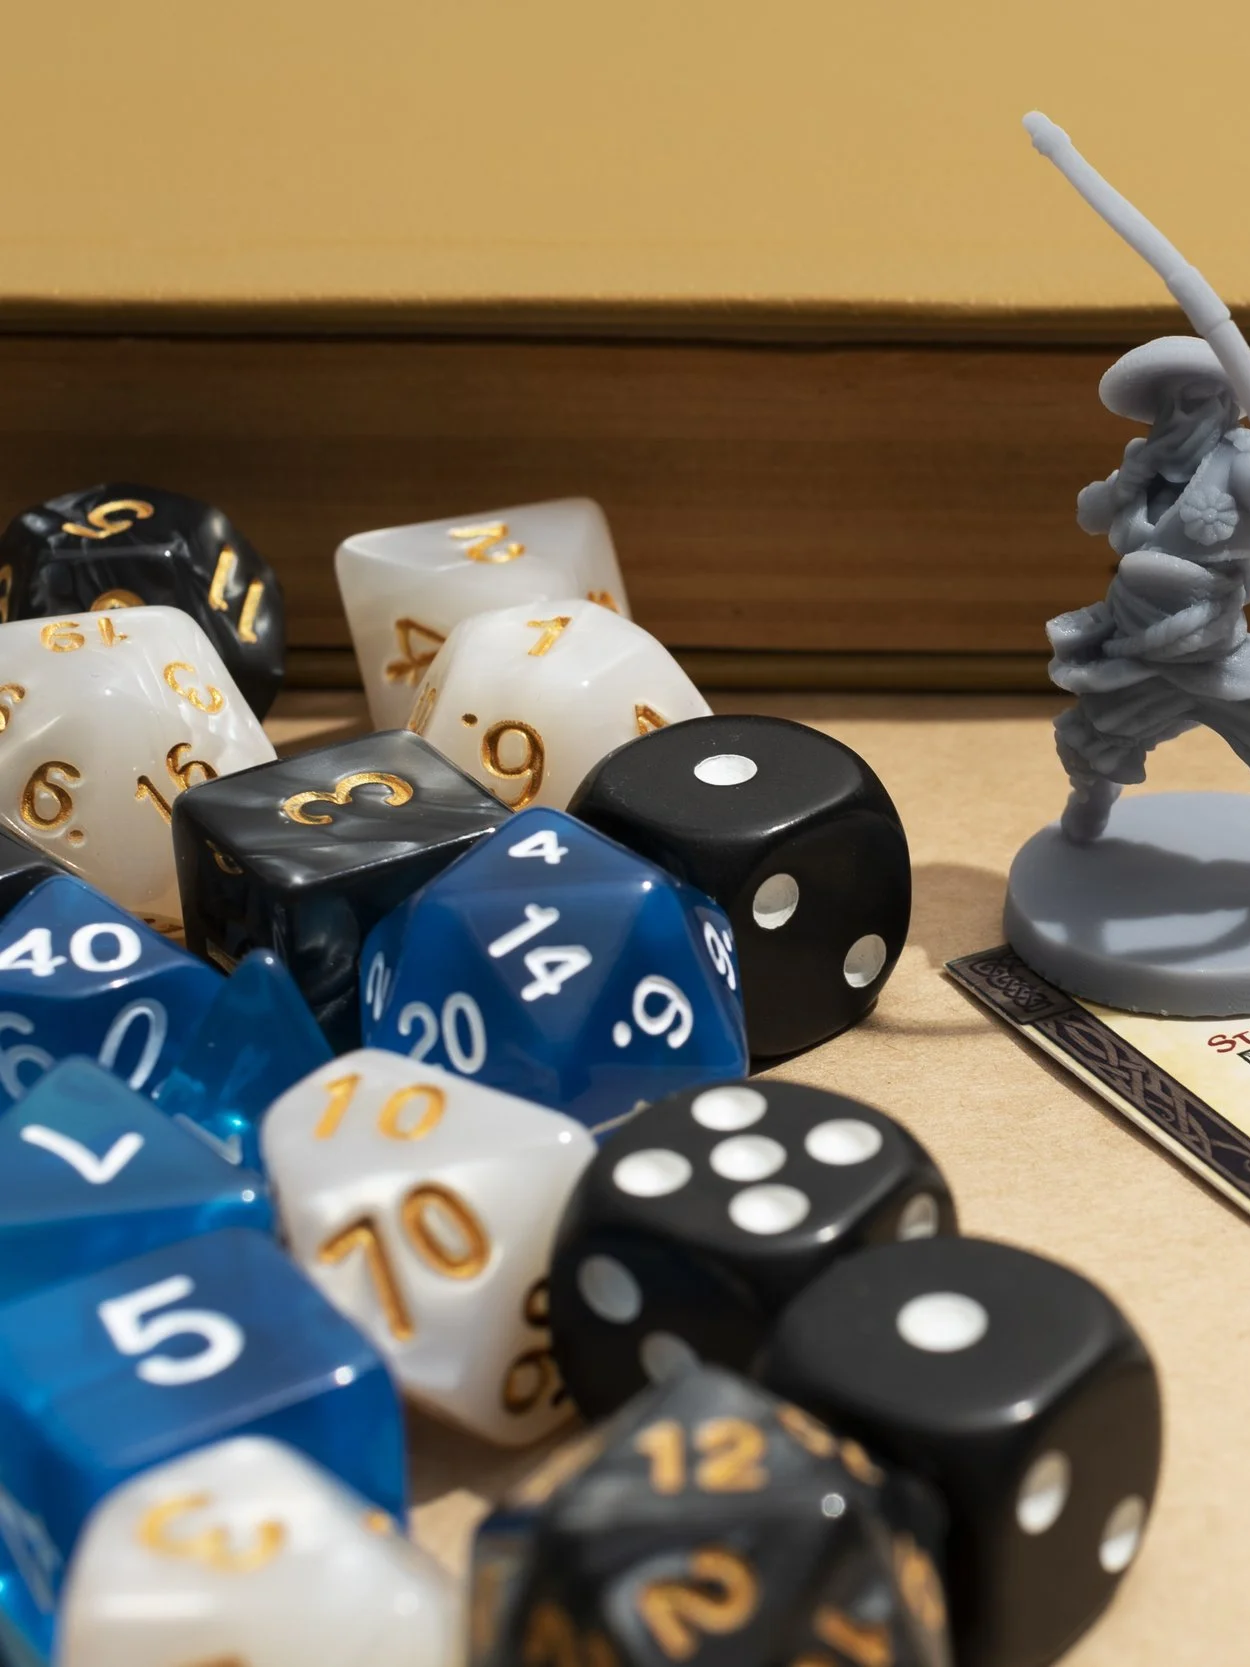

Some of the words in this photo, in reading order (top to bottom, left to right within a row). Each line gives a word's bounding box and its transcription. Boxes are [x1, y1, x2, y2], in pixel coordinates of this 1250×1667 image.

[448, 520, 525, 564] 2
[163, 661, 223, 713] 3
[282, 772, 413, 825] 3
[508, 829, 569, 865] 4
[0, 922, 142, 977] 40
[488, 903, 592, 1002] 14
[398, 991, 486, 1075] 20
[317, 1180, 490, 1343] 70
[97, 1276, 244, 1386] 5
[635, 1417, 769, 1496] 12
[636, 1544, 758, 1661] 2
